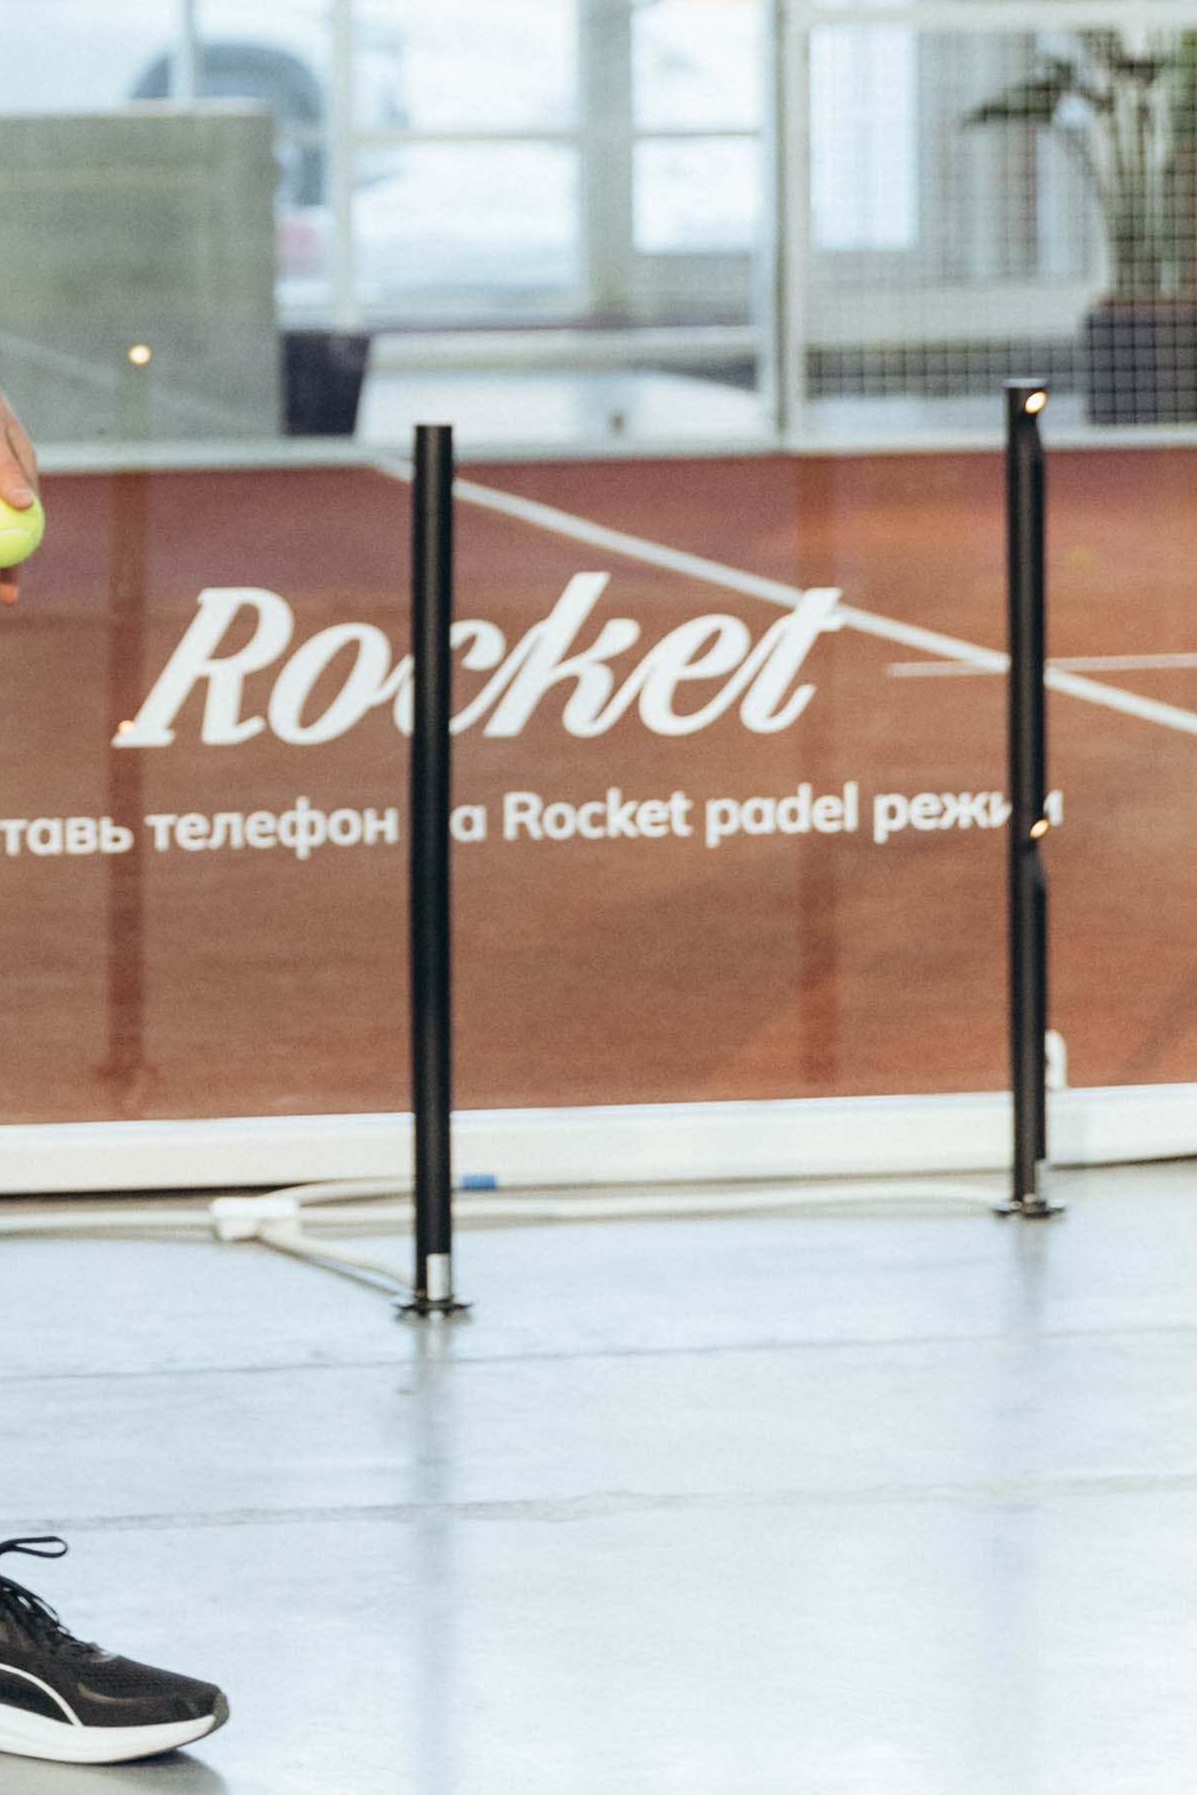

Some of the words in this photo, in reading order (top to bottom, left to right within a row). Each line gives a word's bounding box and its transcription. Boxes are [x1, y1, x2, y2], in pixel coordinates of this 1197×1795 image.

[111, 572, 845, 747] Rocket
[145, 796, 399, 859] телефон
[502, 788, 693, 842] Rocket
[705, 781, 858, 848] padel
